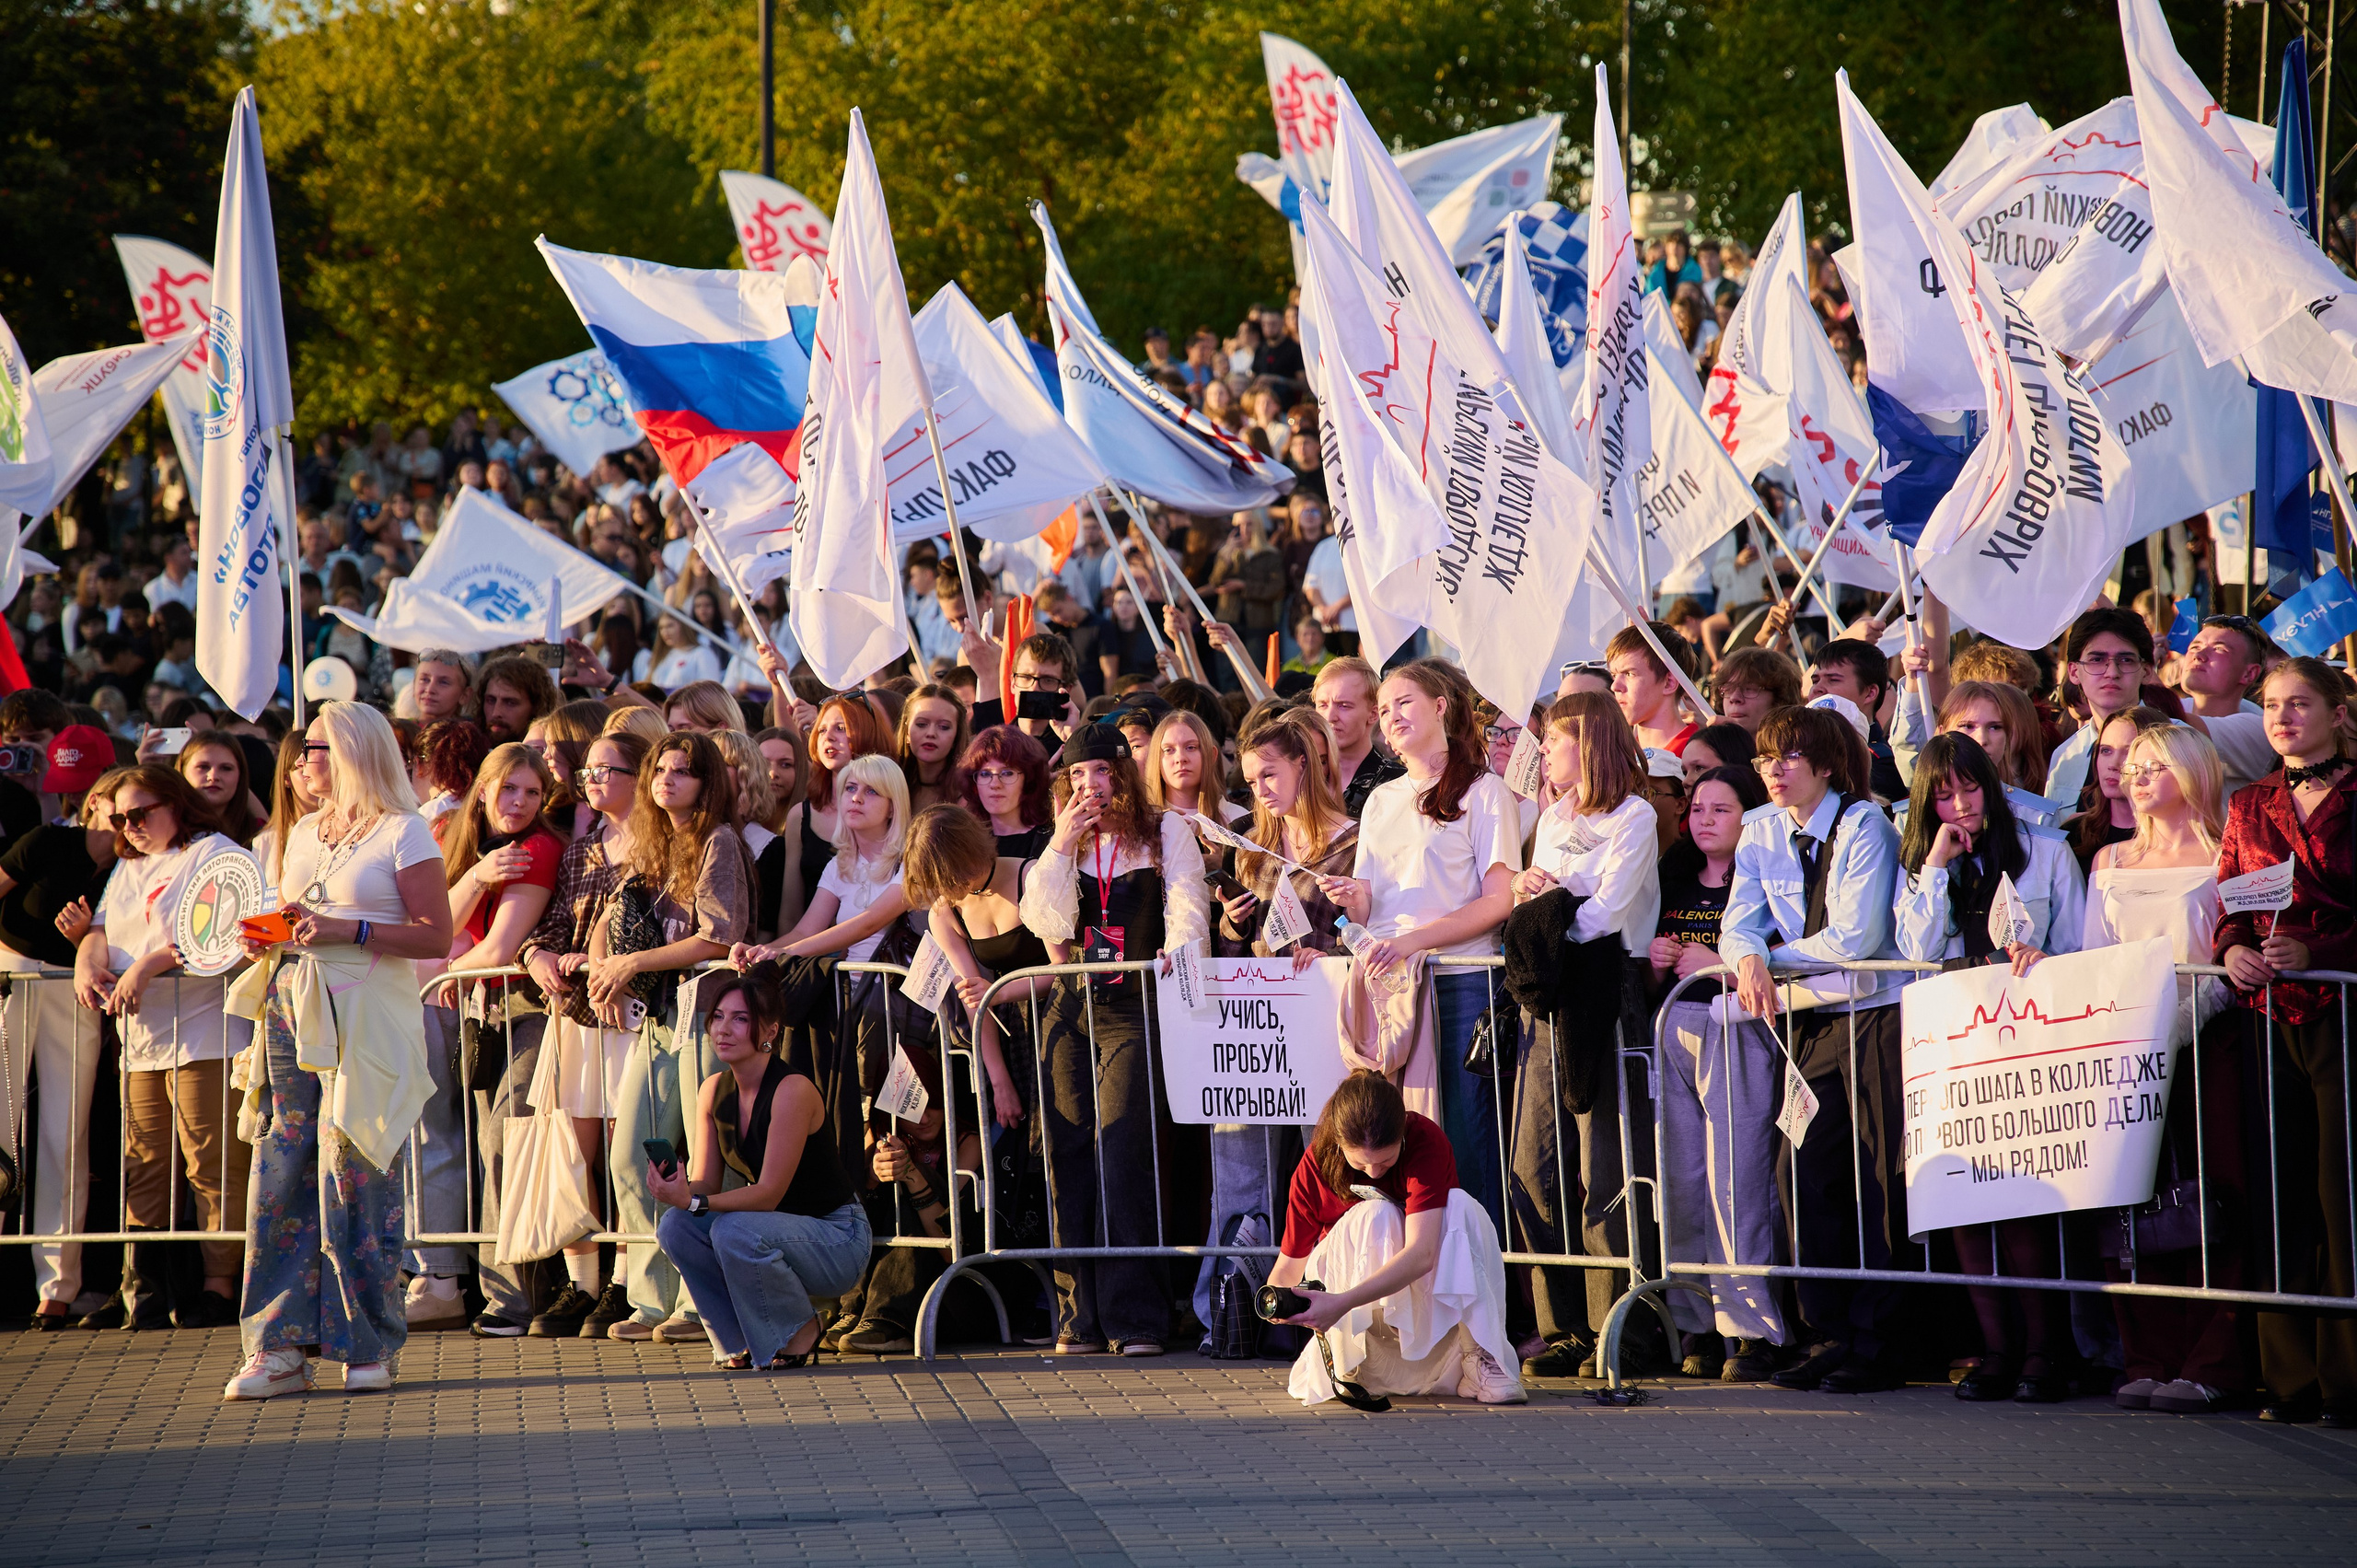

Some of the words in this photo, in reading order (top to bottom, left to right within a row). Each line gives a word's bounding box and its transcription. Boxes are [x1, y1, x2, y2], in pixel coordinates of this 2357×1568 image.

[179, 876, 202, 957] НОВОСИБИРСКИЙ
[202, 855, 261, 898] АВТОТРАНСПОРТНЫЙ
[1275, 913, 1292, 942] ГОРОДСКОЙ
[1178, 977, 1187, 1002] КОЛЛЕДЖ
[1185, 980, 1195, 1008] ГОРОДСКОЙ
[1218, 999, 1284, 1034] УЧИСЬ,
[1213, 1036, 1293, 1078] ПРОБУЙ,
[1974, 1070, 2026, 1106] ШАГА
[2030, 1067, 2043, 1097] В
[2049, 1051, 2167, 1094] КОЛЛЕДЖЕ
[1202, 1080, 1306, 1117] ОТКРЫВАЙ!
[1991, 1098, 2097, 1142] БОЛЬШОГО
[2104, 1091, 2164, 1132] ДЕЛА
[1971, 1151, 2003, 1184] МЫ
[2010, 1139, 2089, 1180] РЯДОМ!
